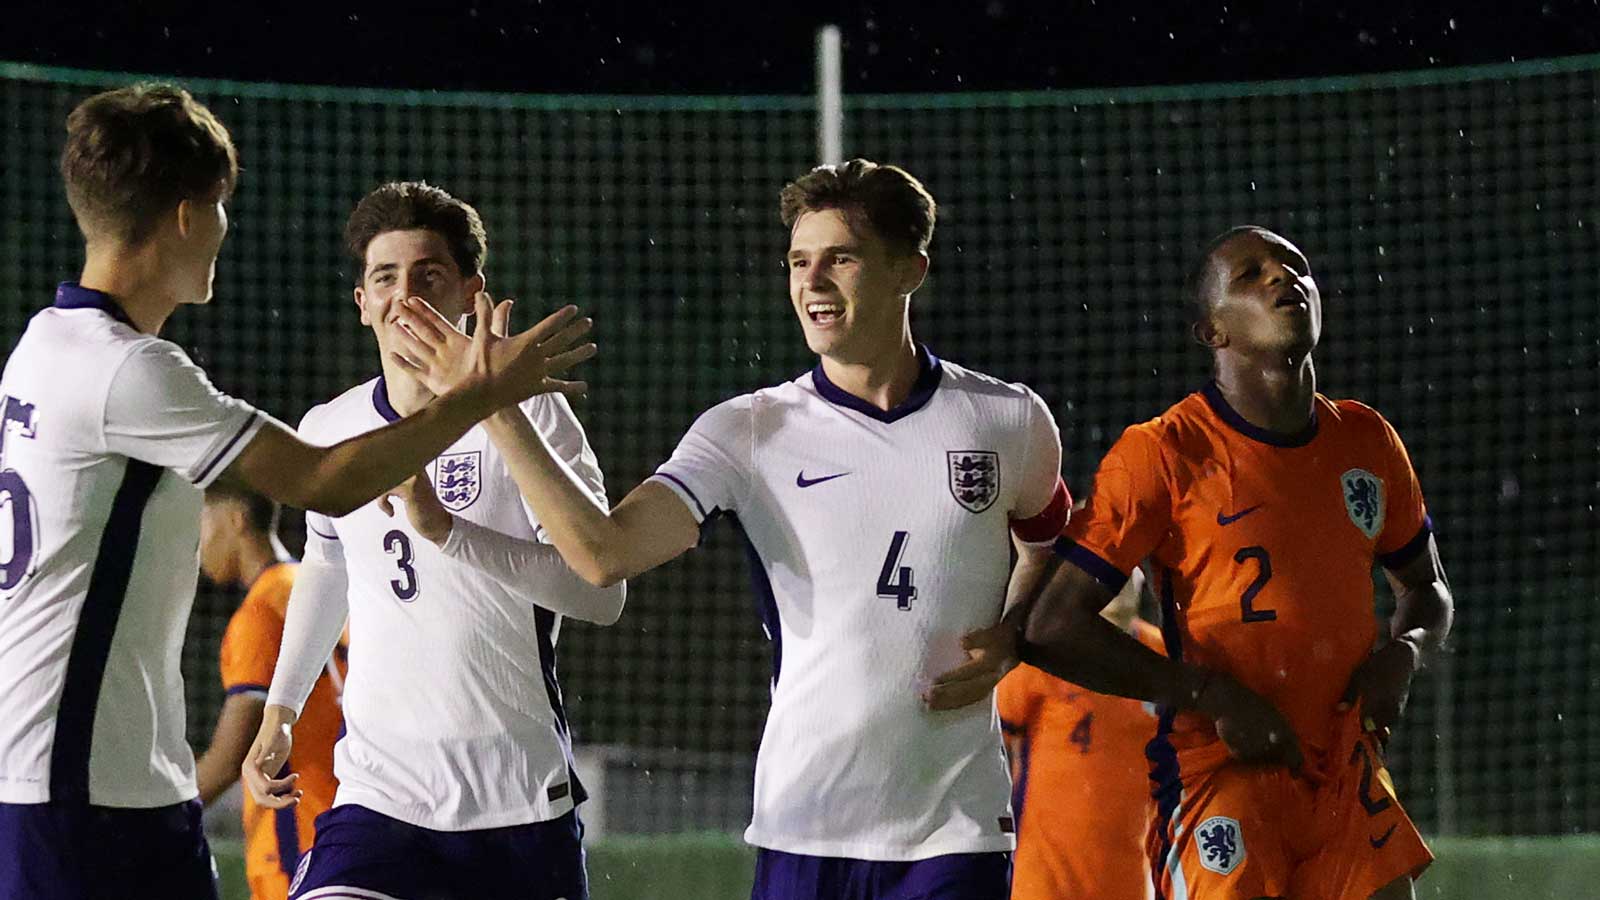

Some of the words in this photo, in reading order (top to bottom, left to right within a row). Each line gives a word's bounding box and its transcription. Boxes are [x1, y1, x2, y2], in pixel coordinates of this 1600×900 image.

[384, 530, 420, 603] 3
[877, 531, 918, 611] 4
[1234, 546, 1277, 623] 2
[1070, 711, 1095, 754] 4
[1351, 741, 1392, 815] 2
